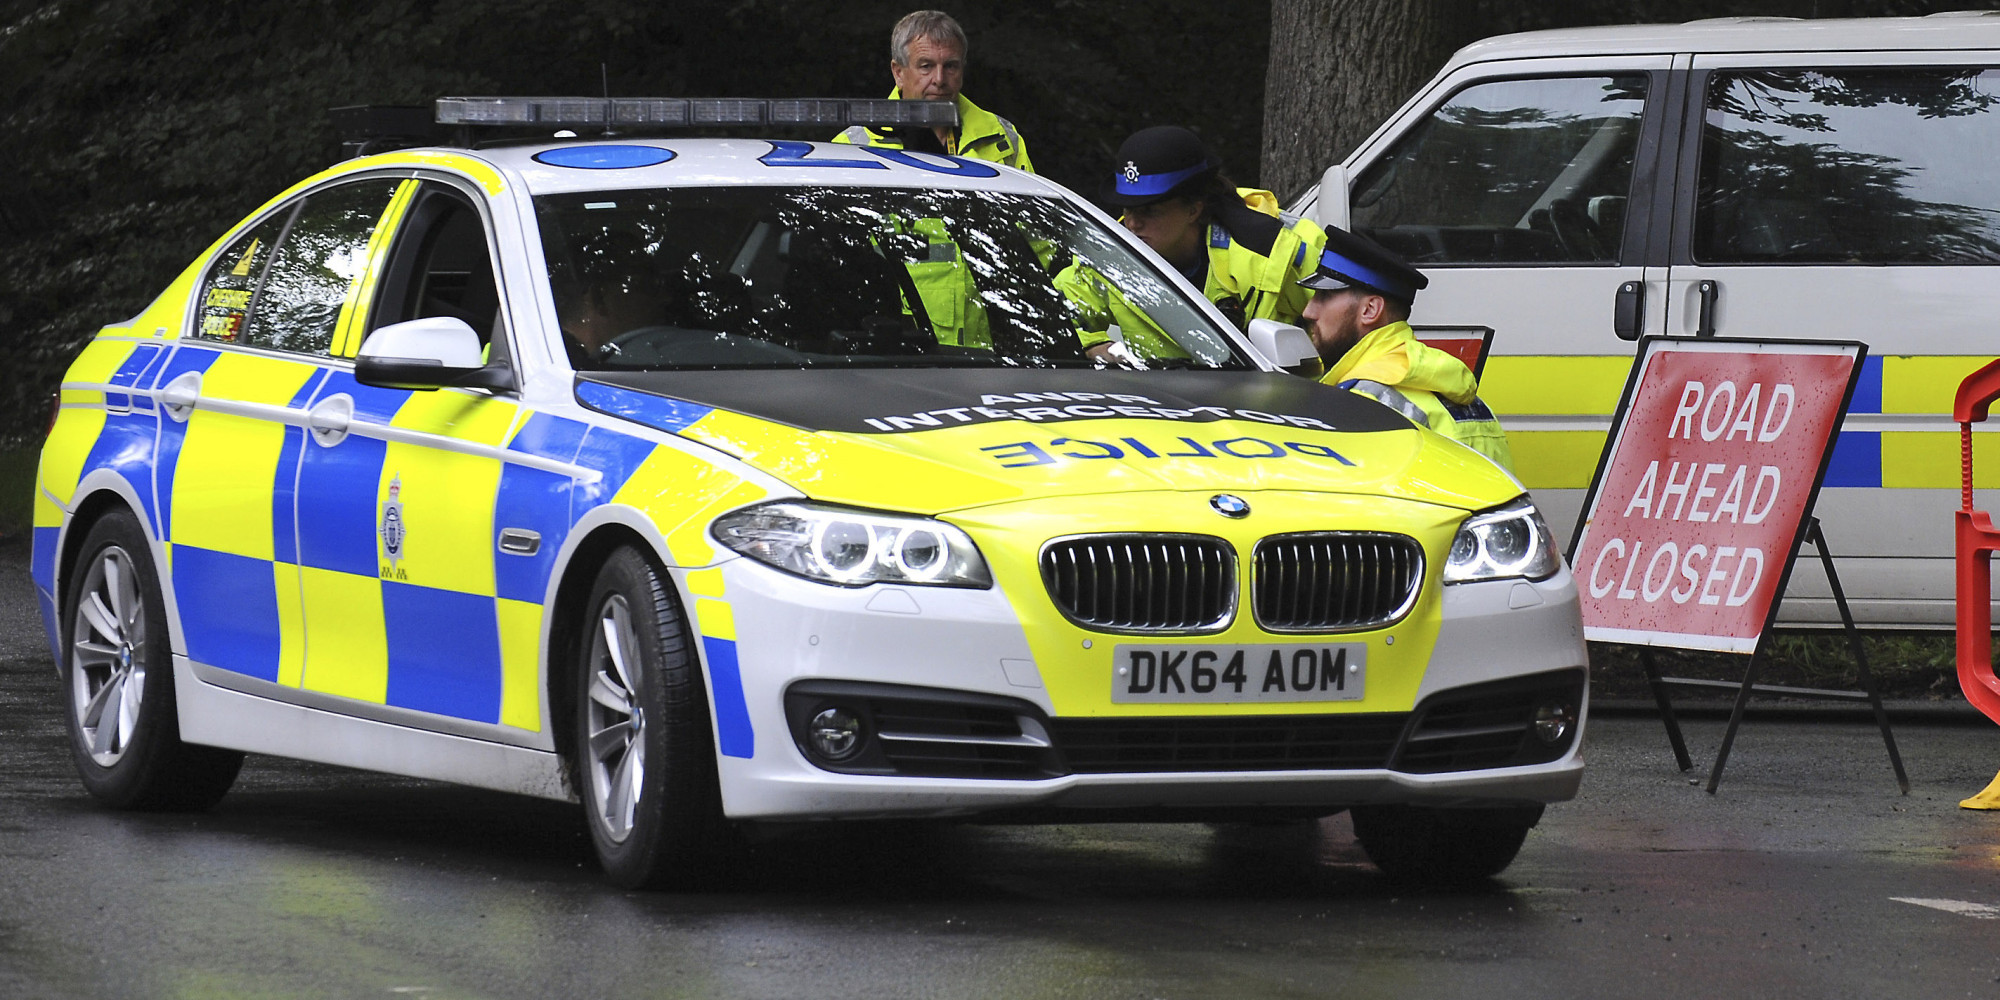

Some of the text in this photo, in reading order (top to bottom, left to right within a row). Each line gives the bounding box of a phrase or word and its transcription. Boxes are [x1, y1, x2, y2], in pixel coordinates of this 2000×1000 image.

[864, 404, 1337, 433] INTERCEPTOR
[981, 391, 1162, 406] ANPR
[1667, 380, 1796, 443] ROAD
[1623, 460, 1782, 524] AHEAD
[1588, 538, 1765, 608] CLOSED
[1128, 648, 1347, 694] DK64 AOM
